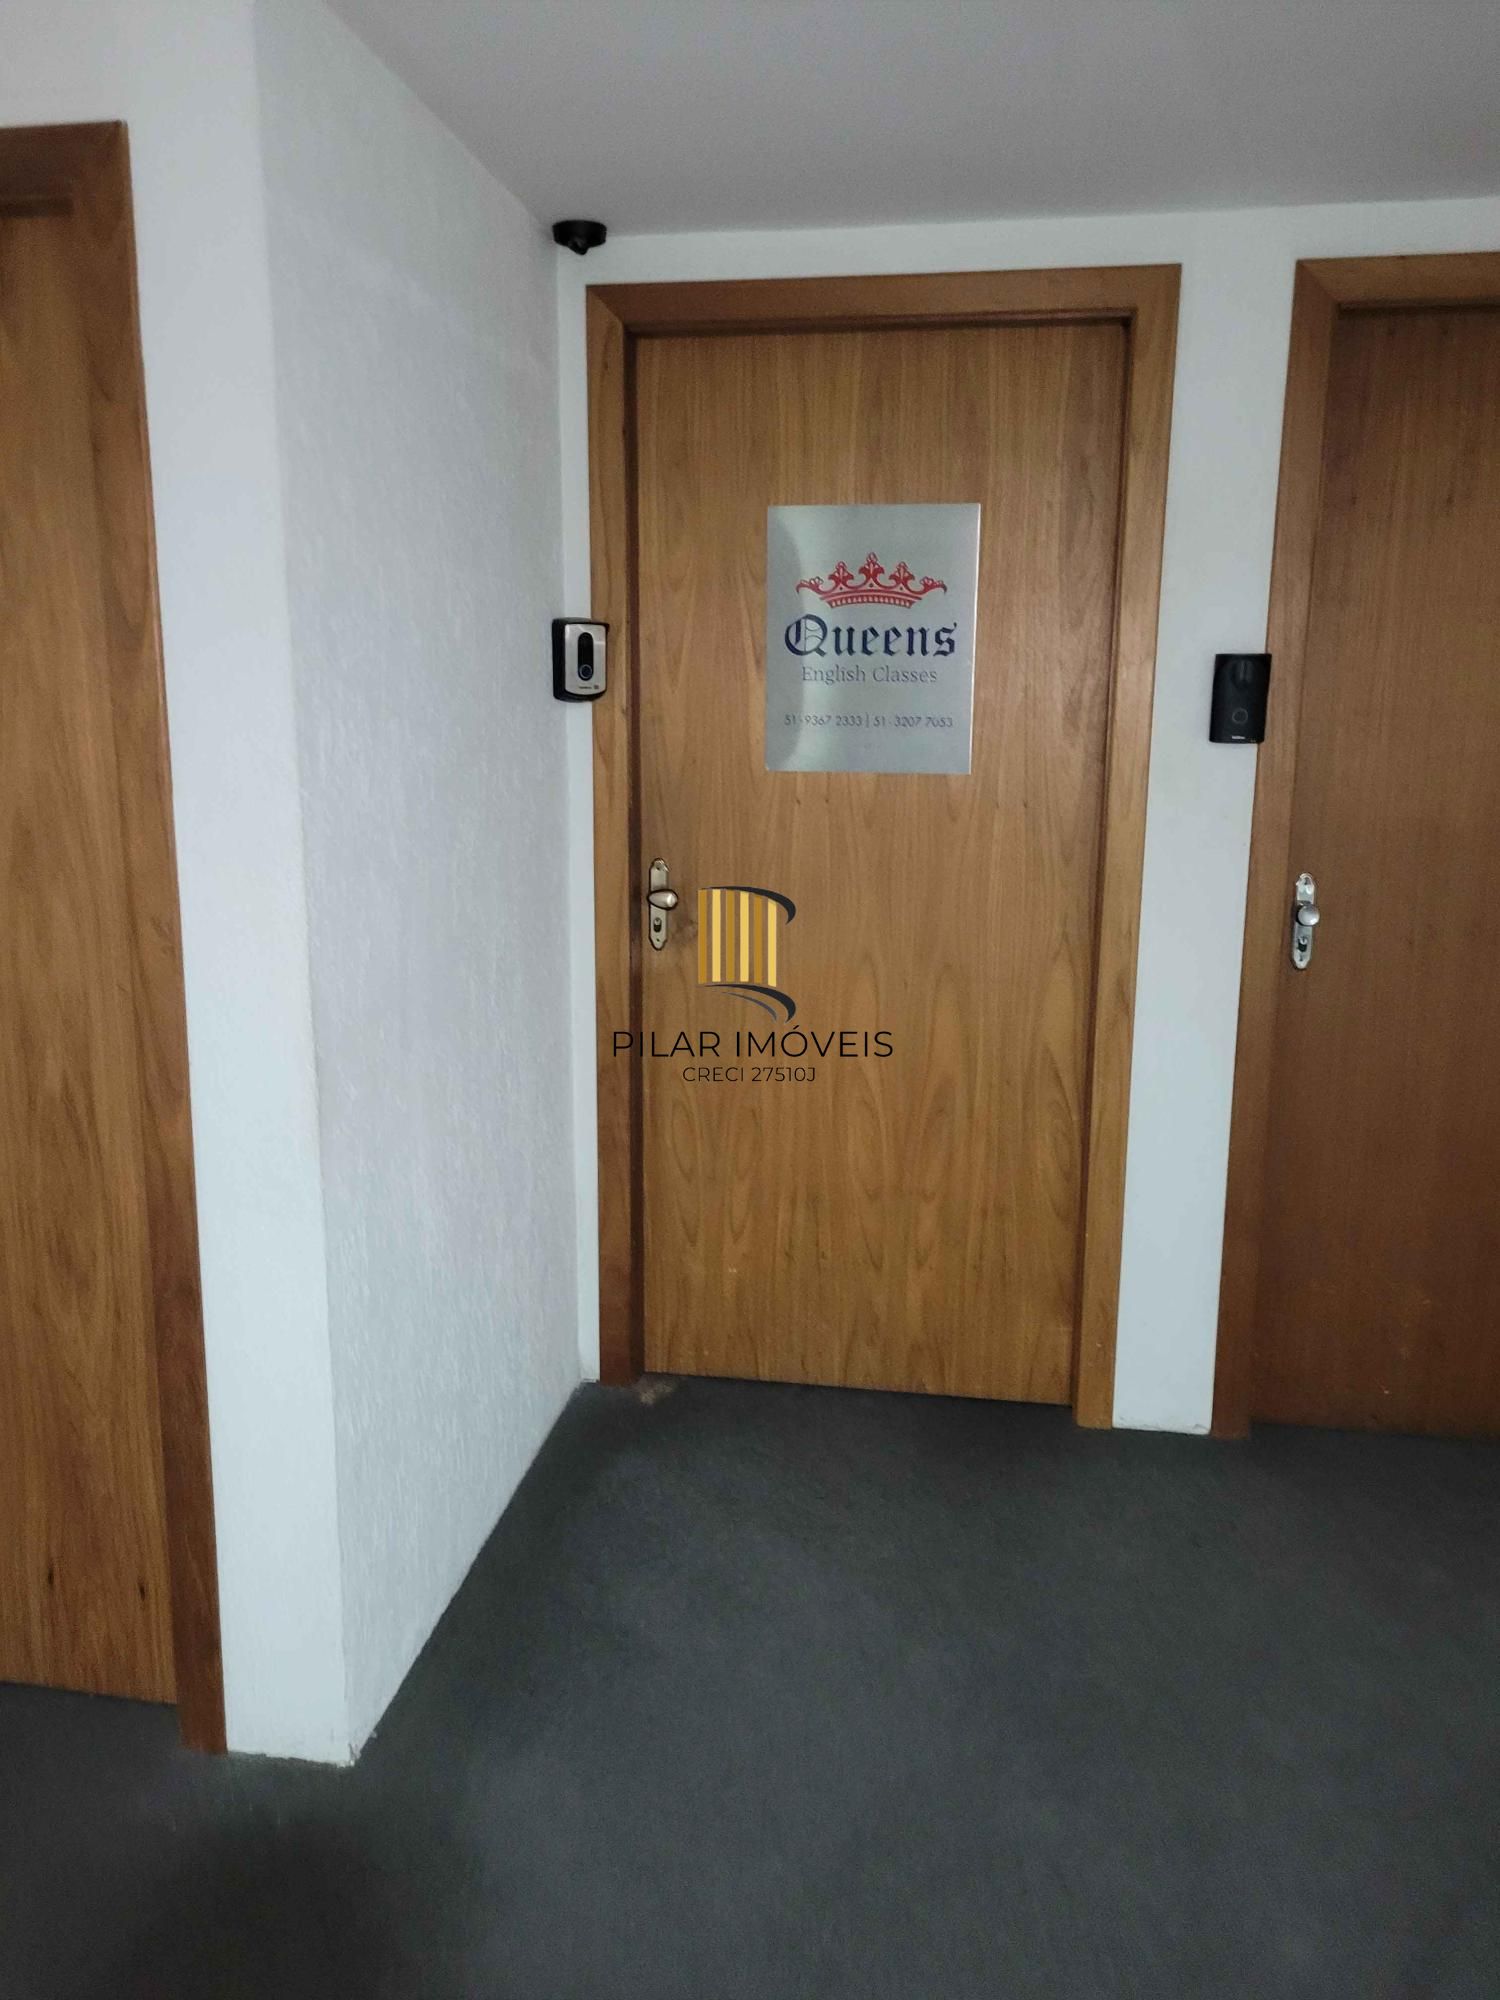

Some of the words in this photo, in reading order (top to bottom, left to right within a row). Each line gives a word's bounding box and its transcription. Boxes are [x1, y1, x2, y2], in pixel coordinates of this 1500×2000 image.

[802, 664, 866, 685] English
[872, 665, 938, 683] Classes
[835, 714, 863, 728] 2333
